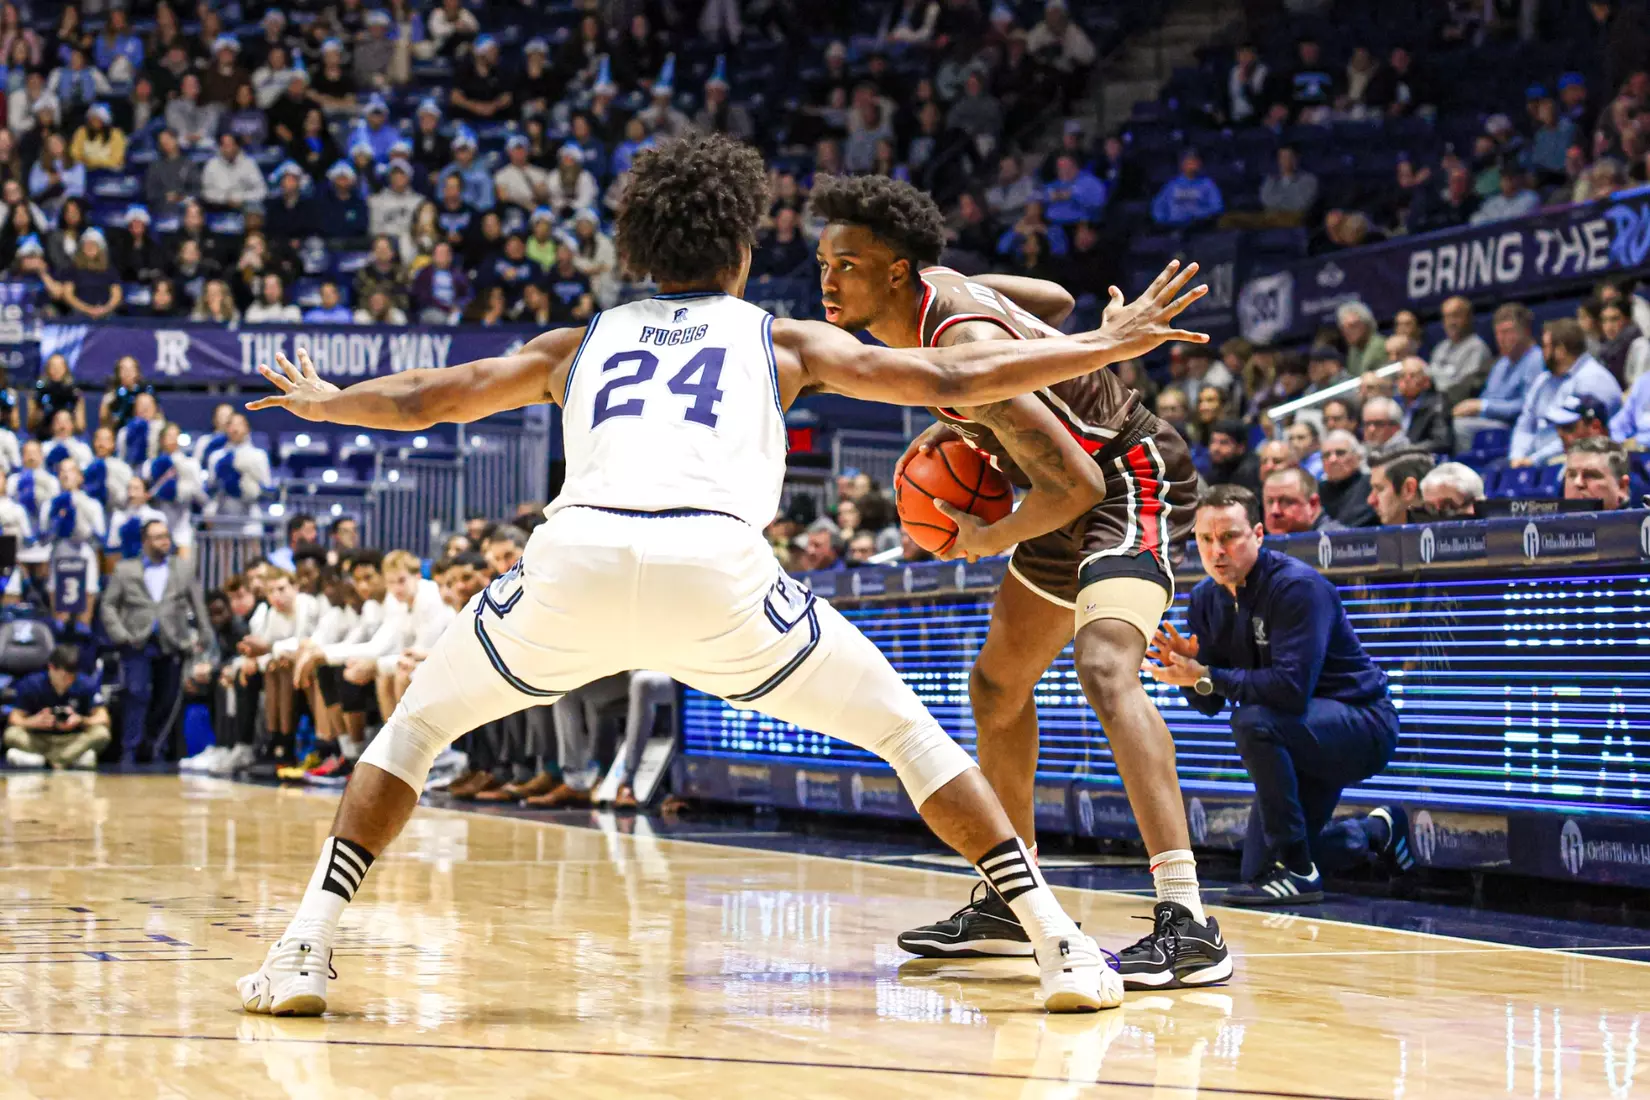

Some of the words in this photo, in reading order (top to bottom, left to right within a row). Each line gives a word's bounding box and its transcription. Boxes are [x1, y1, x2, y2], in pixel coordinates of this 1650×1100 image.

[1407, 231, 1524, 298] BRING
[1535, 218, 1610, 276] THE
[238, 332, 287, 375] THE
[389, 334, 452, 373] WAY
[639, 323, 709, 346] FUCHS
[590, 346, 729, 433] 24
